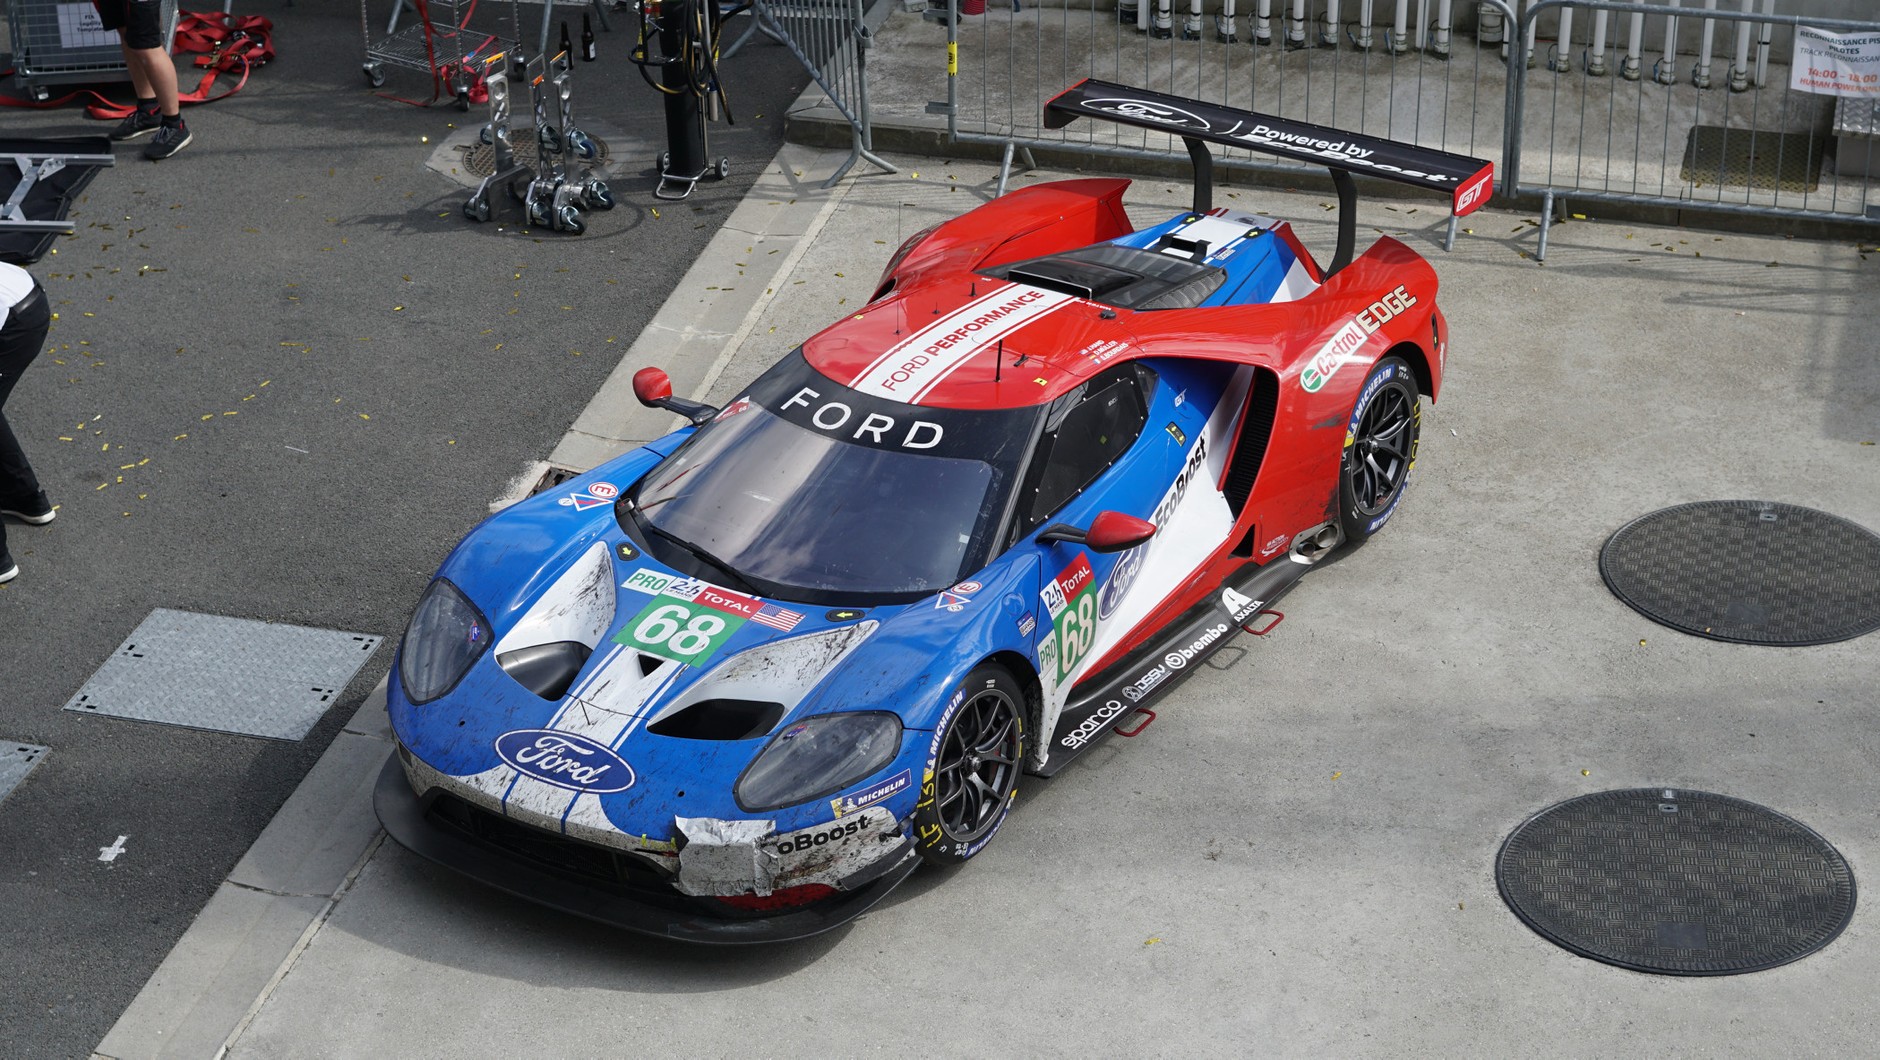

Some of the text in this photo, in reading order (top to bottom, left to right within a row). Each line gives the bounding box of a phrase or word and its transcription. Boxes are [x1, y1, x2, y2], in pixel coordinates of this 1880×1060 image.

[1800, 31, 1867, 46] RECONNAISSANCE
[1800, 47, 1823, 57] TRACK
[1828, 45, 1860, 55] PILOTES
[1800, 78, 1831, 88] HUMAN
[1808, 67, 1838, 79] 14:00
[1099, 103, 1192, 127] Ford
[1250, 124, 1375, 159] Powered by
[1456, 173, 1493, 213] GT
[1355, 284, 1417, 335] EDGE
[881, 290, 1045, 391] FORD PERFORMANCE
[1316, 326, 1363, 377] Castrol
[1355, 367, 1391, 420] MICHELIN
[780, 386, 944, 449] FORD
[628, 572, 668, 591] PRO
[1061, 566, 1090, 594] TOTAL
[704, 591, 752, 614] TOTAL
[1233, 600, 1264, 622] AXALTA
[633, 604, 726, 656] 68
[1062, 593, 1093, 674] 68
[1179, 623, 1228, 660] brembo
[1040, 638, 1056, 671] PRO
[930, 691, 964, 756] MICHELIN
[1061, 700, 1122, 746] sparco
[515, 735, 612, 784] Ford
[857, 777, 906, 806] MICHELIN
